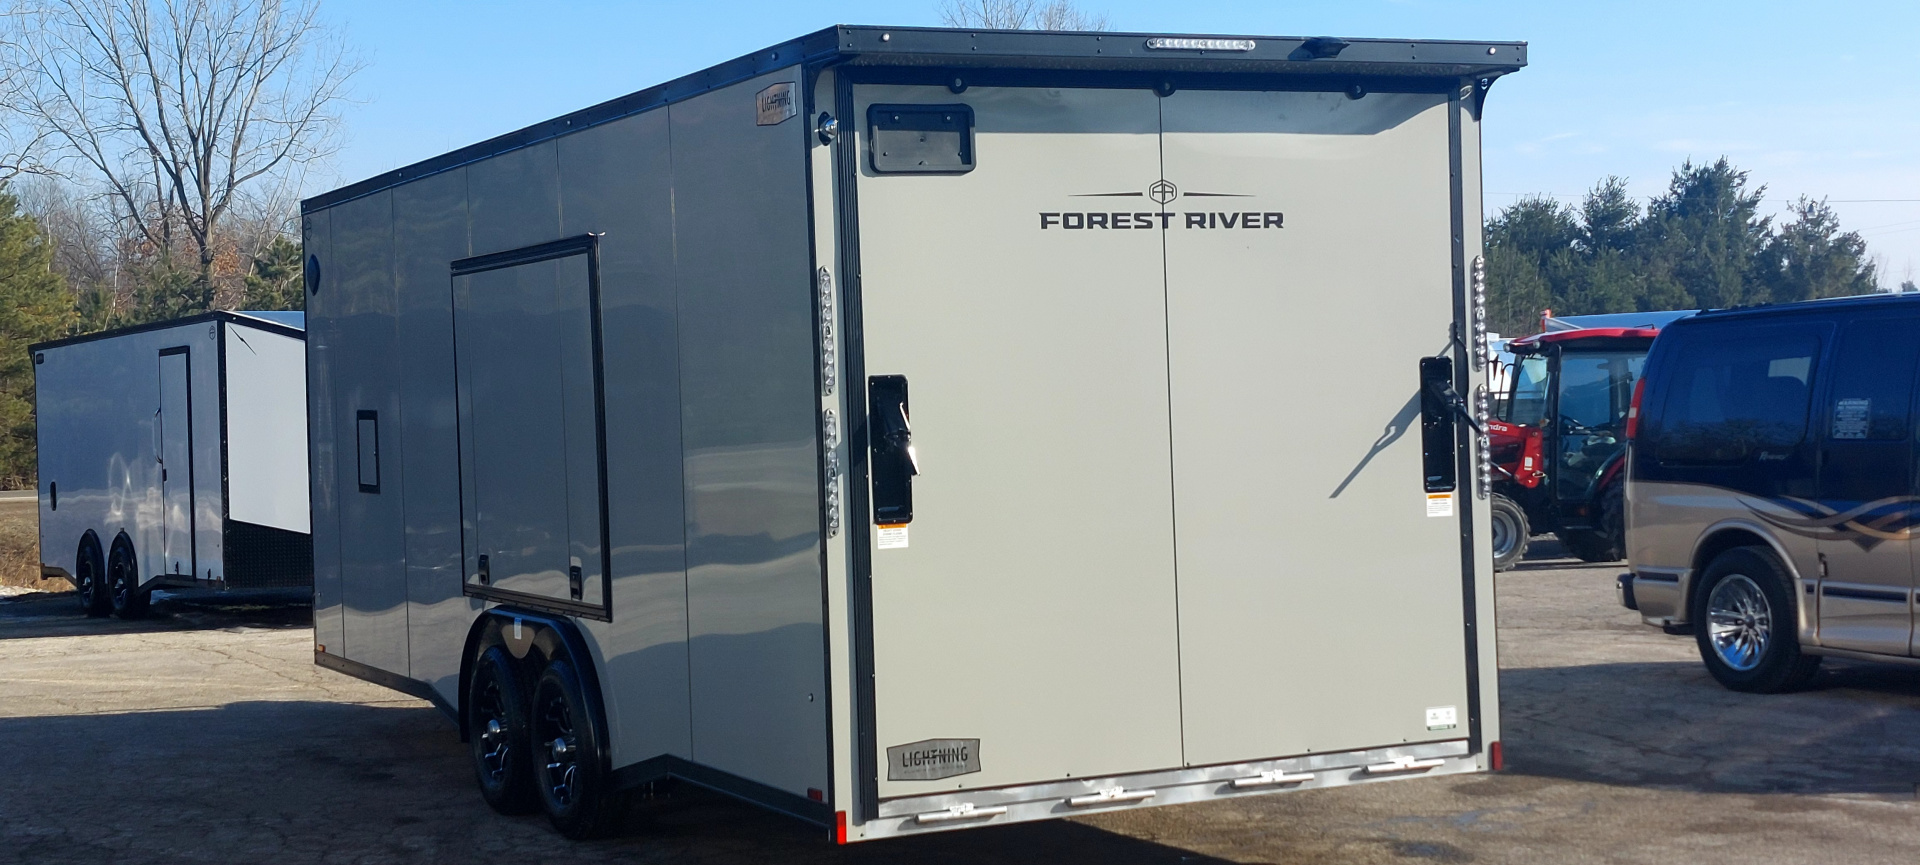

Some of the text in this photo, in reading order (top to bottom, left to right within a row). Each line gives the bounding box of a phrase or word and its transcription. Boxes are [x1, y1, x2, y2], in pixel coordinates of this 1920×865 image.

[1039, 211, 1284, 230] FOREST RIVER
[902, 746, 968, 768] LIGHTNING
